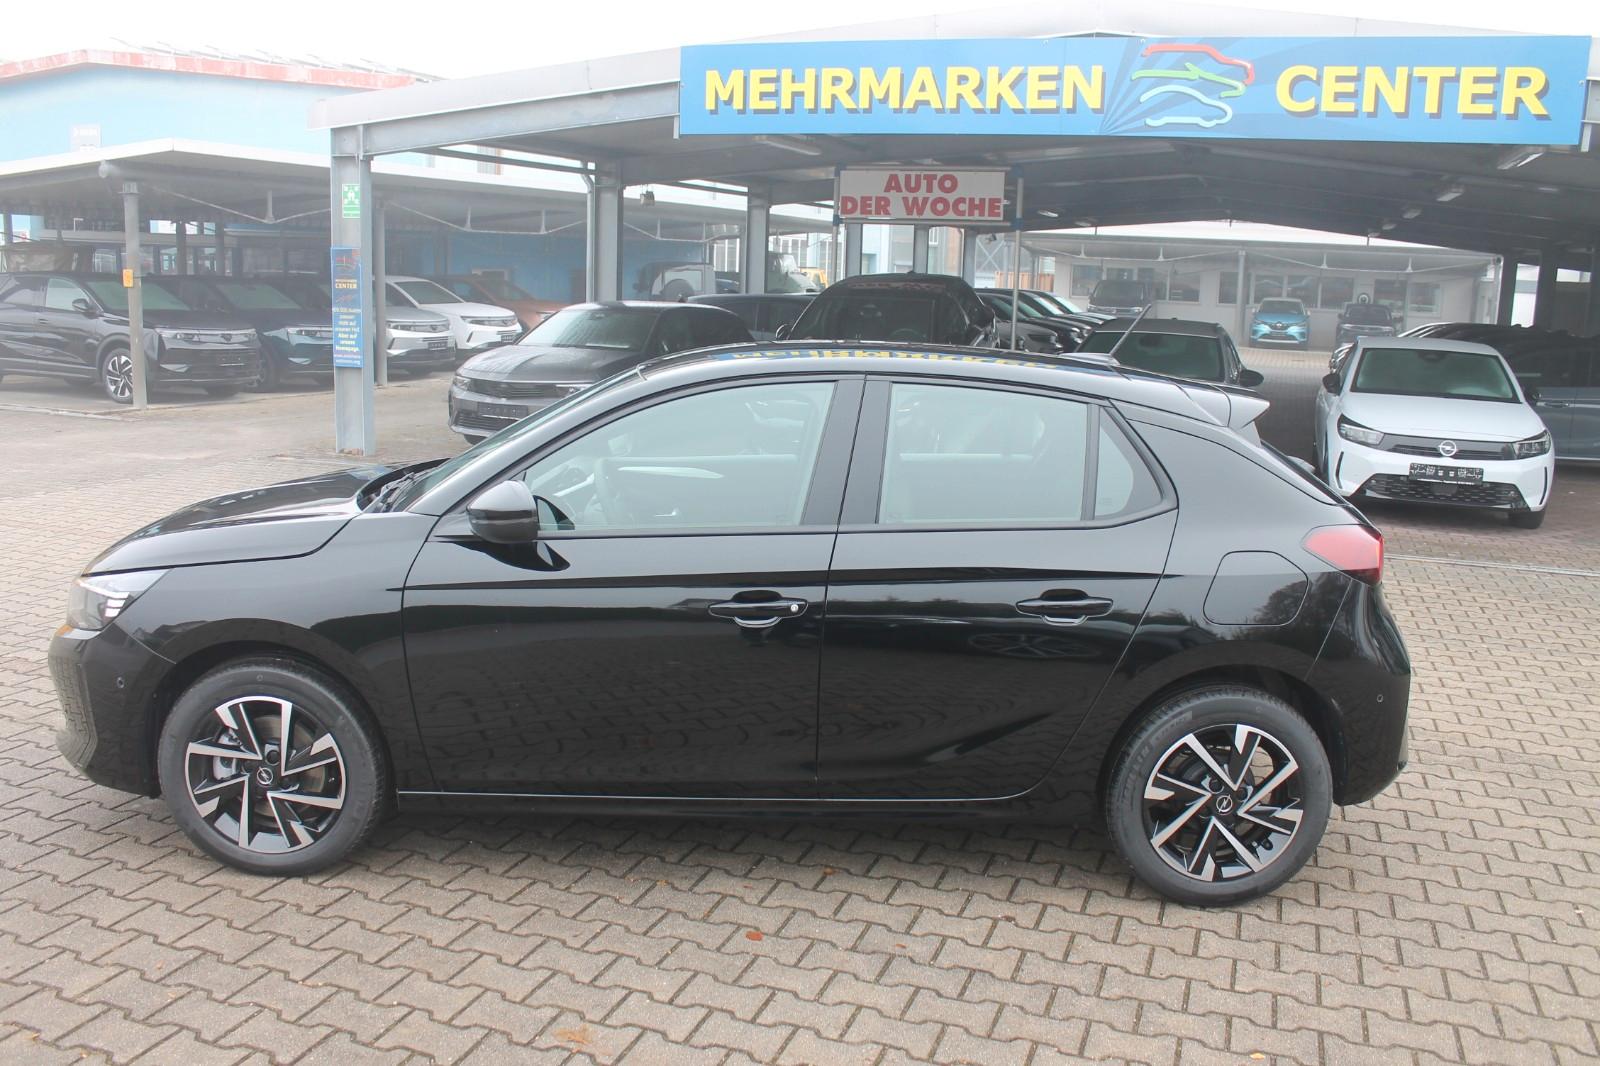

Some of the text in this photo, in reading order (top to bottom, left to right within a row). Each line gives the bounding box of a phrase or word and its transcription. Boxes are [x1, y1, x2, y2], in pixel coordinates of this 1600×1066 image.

[704, 65, 1550, 117] MEHRMARKEN CENTER
[883, 173, 959, 194] AUTO
[840, 196, 1003, 218] DER WOCHE
